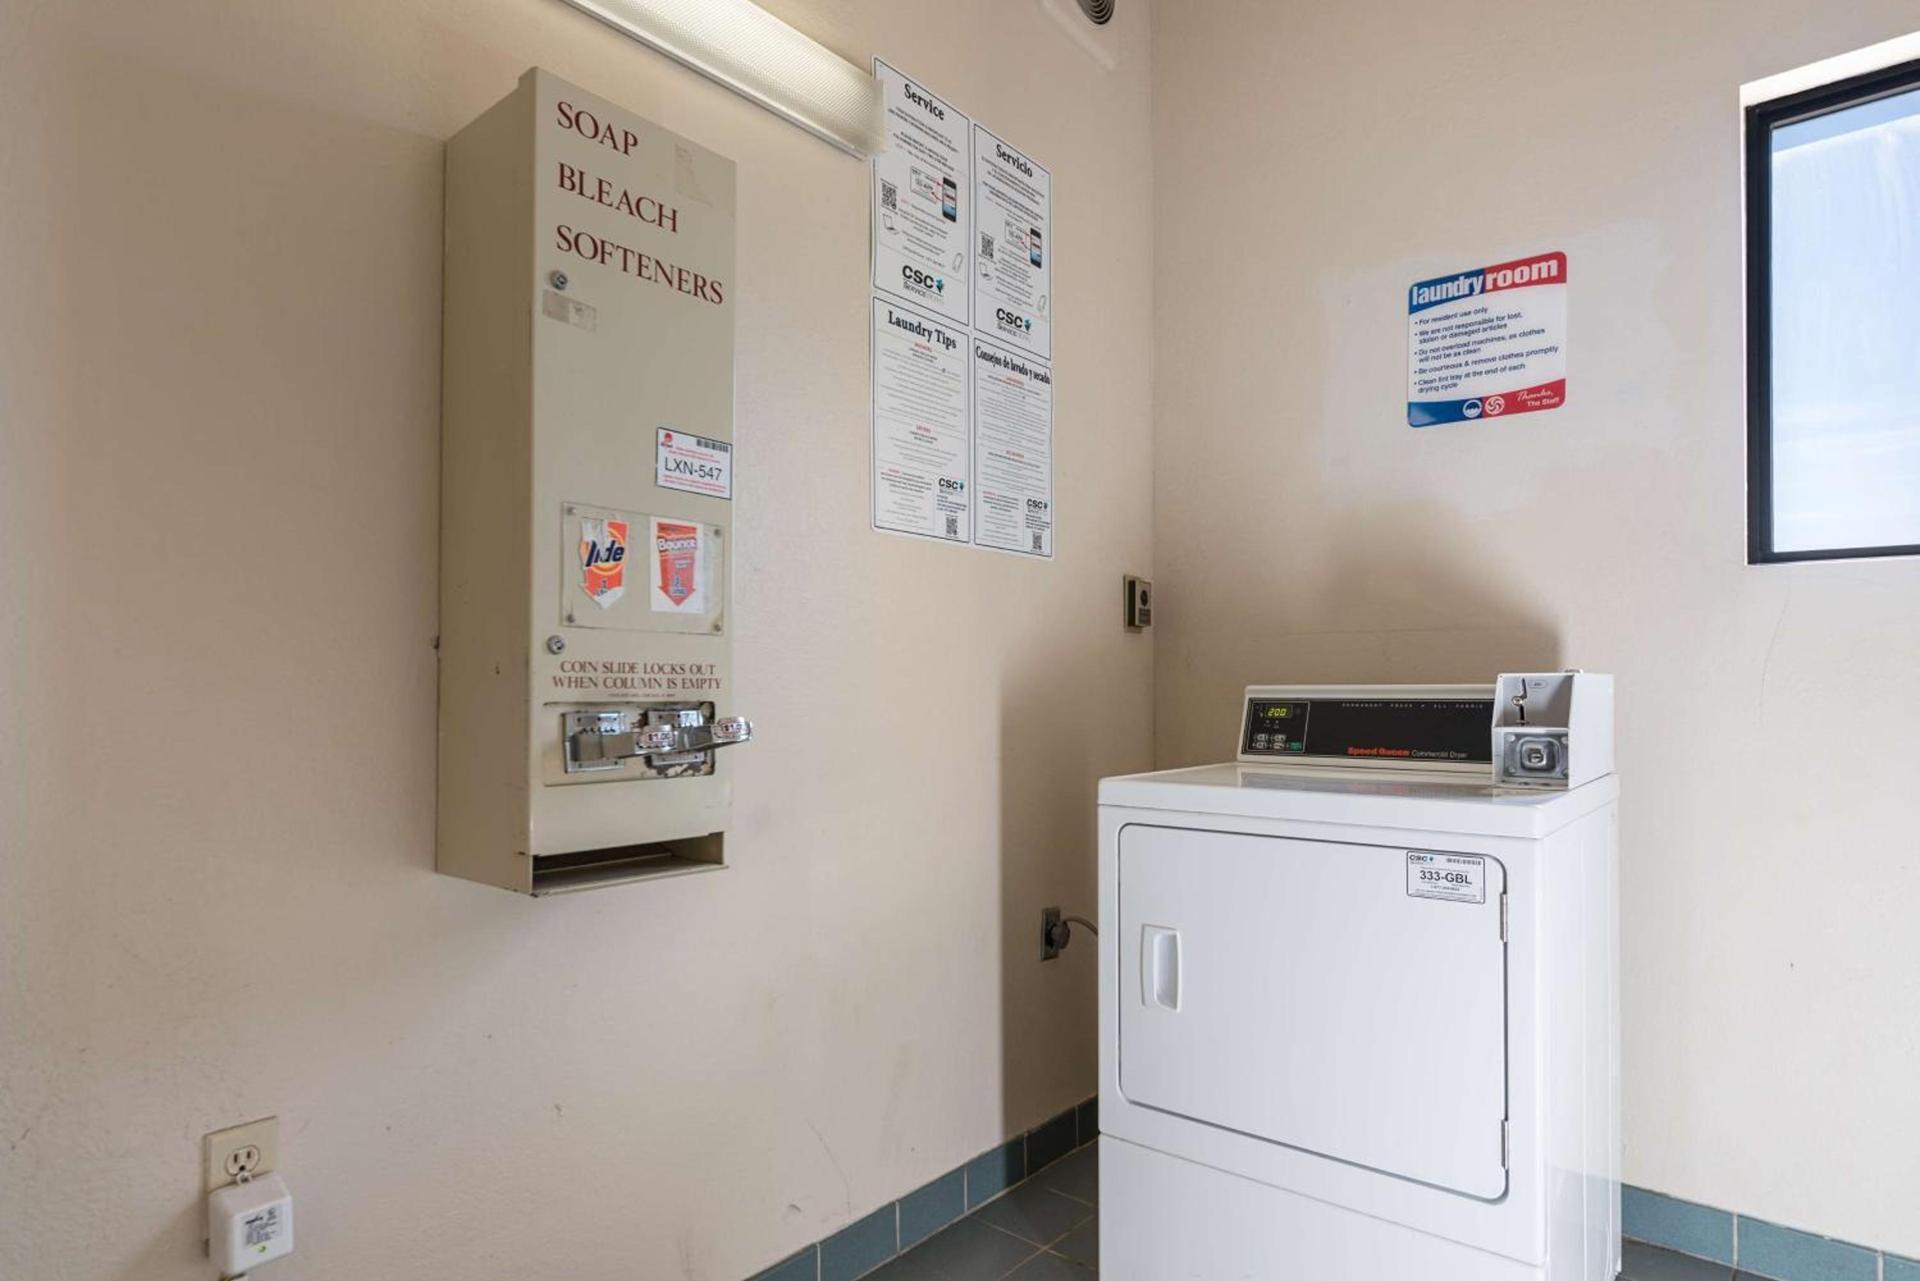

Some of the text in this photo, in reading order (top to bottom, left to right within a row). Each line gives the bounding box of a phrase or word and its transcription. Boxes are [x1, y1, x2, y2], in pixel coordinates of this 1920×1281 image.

[904, 83, 945, 121] Service
[556, 101, 638, 157] SOAP
[996, 144, 1033, 178] Servicio
[558, 161, 679, 233] BLEACH
[556, 224, 723, 305] SOFTENERS
[902, 264, 934, 290] CSC
[996, 308, 1023, 329] CSC
[1474, 306, 1488, 315] only
[888, 310, 957, 350] Laundry Tips
[1449, 328, 1481, 338] damaged
[1482, 323, 1507, 332] articles
[1455, 318, 1494, 330] responsible
[1418, 348, 1428, 356] Do
[1430, 346, 1440, 354] not
[1442, 342, 1470, 352] overload
[1519, 328, 1546, 338] clothes
[1429, 362, 1462, 373] courteous
[1471, 356, 1497, 365] remove
[1499, 352, 1524, 361] clothes
[1526, 346, 1559, 358] promptly
[1463, 348, 1481, 356] clean
[1003, 356, 1010, 369] de
[1418, 378, 1436, 386] Clean
[1484, 367, 1498, 376] end
[1509, 363, 1526, 372] each
[1418, 382, 1458, 394] drying cycle
[665, 456, 722, 481] LXN-547
[938, 478, 958, 490] CSC
[1026, 499, 1043, 510] CSC
[560, 660, 716, 676] COIN SLIDE LOCKS OUT
[553, 676, 722, 690] WHEN COLUMN IS EMPTY
[1268, 708, 1287, 717] 200
[1420, 870, 1472, 885] 333-GBL
